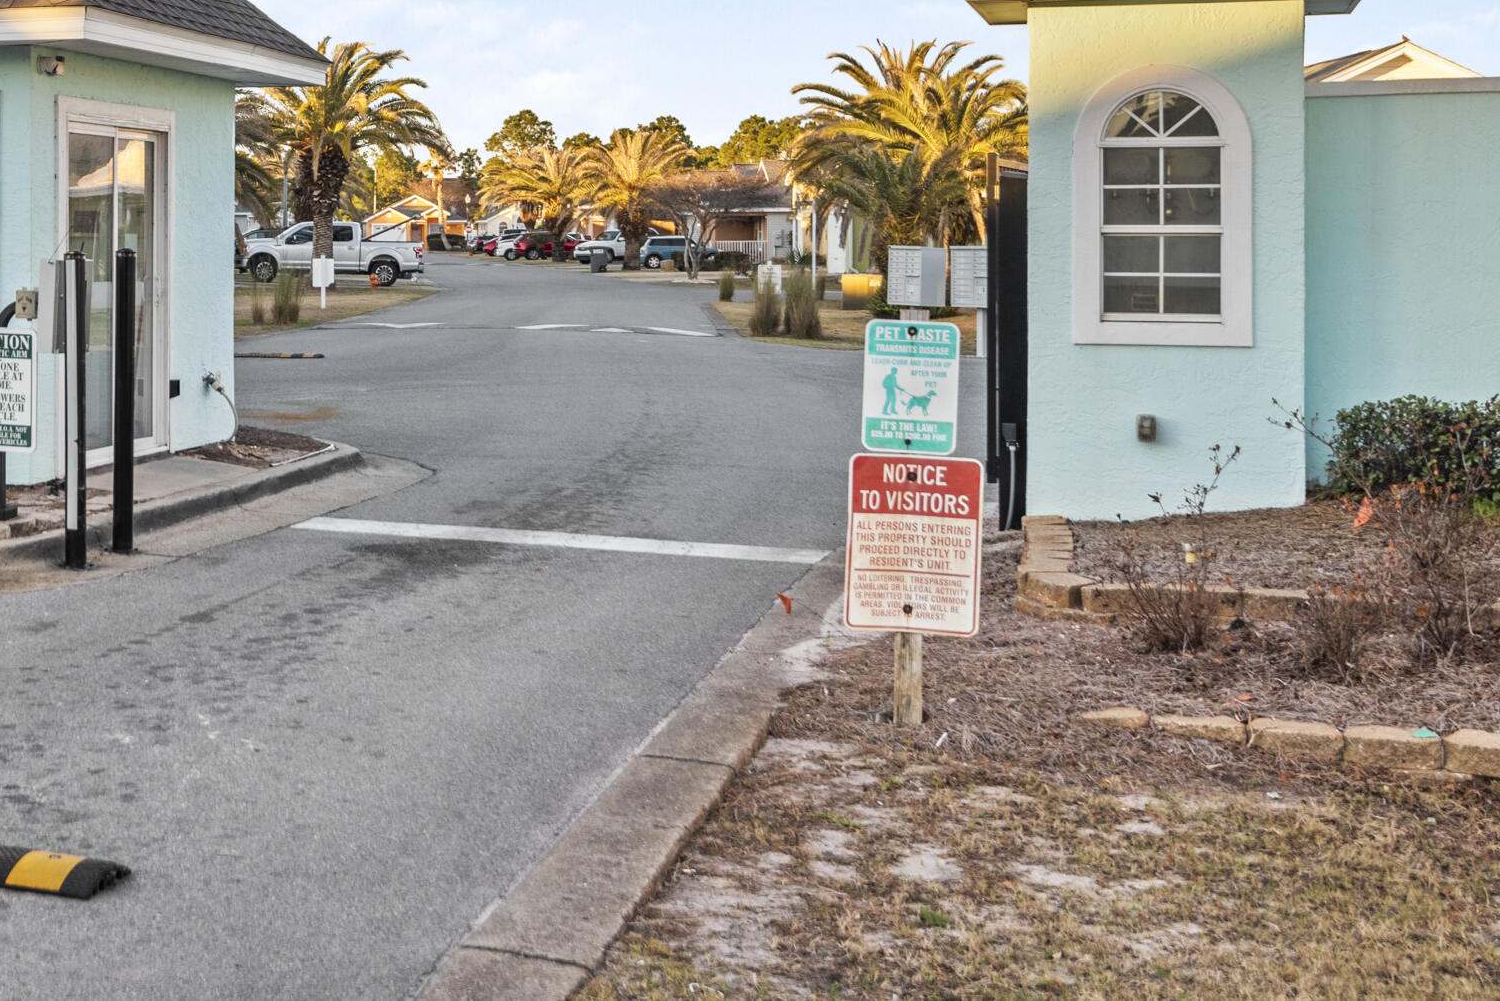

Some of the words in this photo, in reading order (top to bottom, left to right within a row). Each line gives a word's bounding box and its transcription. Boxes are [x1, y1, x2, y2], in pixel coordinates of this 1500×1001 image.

[876, 326, 900, 338] PET
[11, 349, 28, 358] ARM
[876, 344, 916, 353] TRANSMITS
[919, 346, 949, 355] DISEASE
[0, 362, 19, 372] ONE
[12, 372, 24, 381] AT
[0, 402, 24, 412] EACH
[880, 420, 896, 430] IT'S
[899, 422, 914, 432] THE
[916, 423, 938, 433] LAW!
[882, 462, 948, 486] NOTICE
[860, 490, 880, 510] TO
[886, 490, 970, 515] VISITORS
[856, 520, 872, 530] ALL
[876, 521, 918, 532] PERSONS
[922, 523, 971, 536] ENTERING
[856, 532, 875, 542] THIS
[878, 533, 927, 545] PROPERTY
[931, 536, 972, 548] SHOULD
[860, 544, 900, 555] PROCEED
[903, 546, 949, 558] DIRECTLY
[954, 550, 966, 560] TO
[870, 556, 924, 568] RESIDENT'S
[927, 560, 952, 570] UNIT.
[853, 582, 888, 590] GAMBLING
[903, 584, 932, 594] ILLEGAL
[935, 586, 969, 596] ACTIVITY
[864, 592, 902, 600] PERMITTED
[915, 594, 928, 602] THE
[931, 595, 966, 605] COMMON
[871, 609, 900, 617] SUBJECT
[930, 604, 948, 612] WILL
[950, 606, 959, 614] BE
